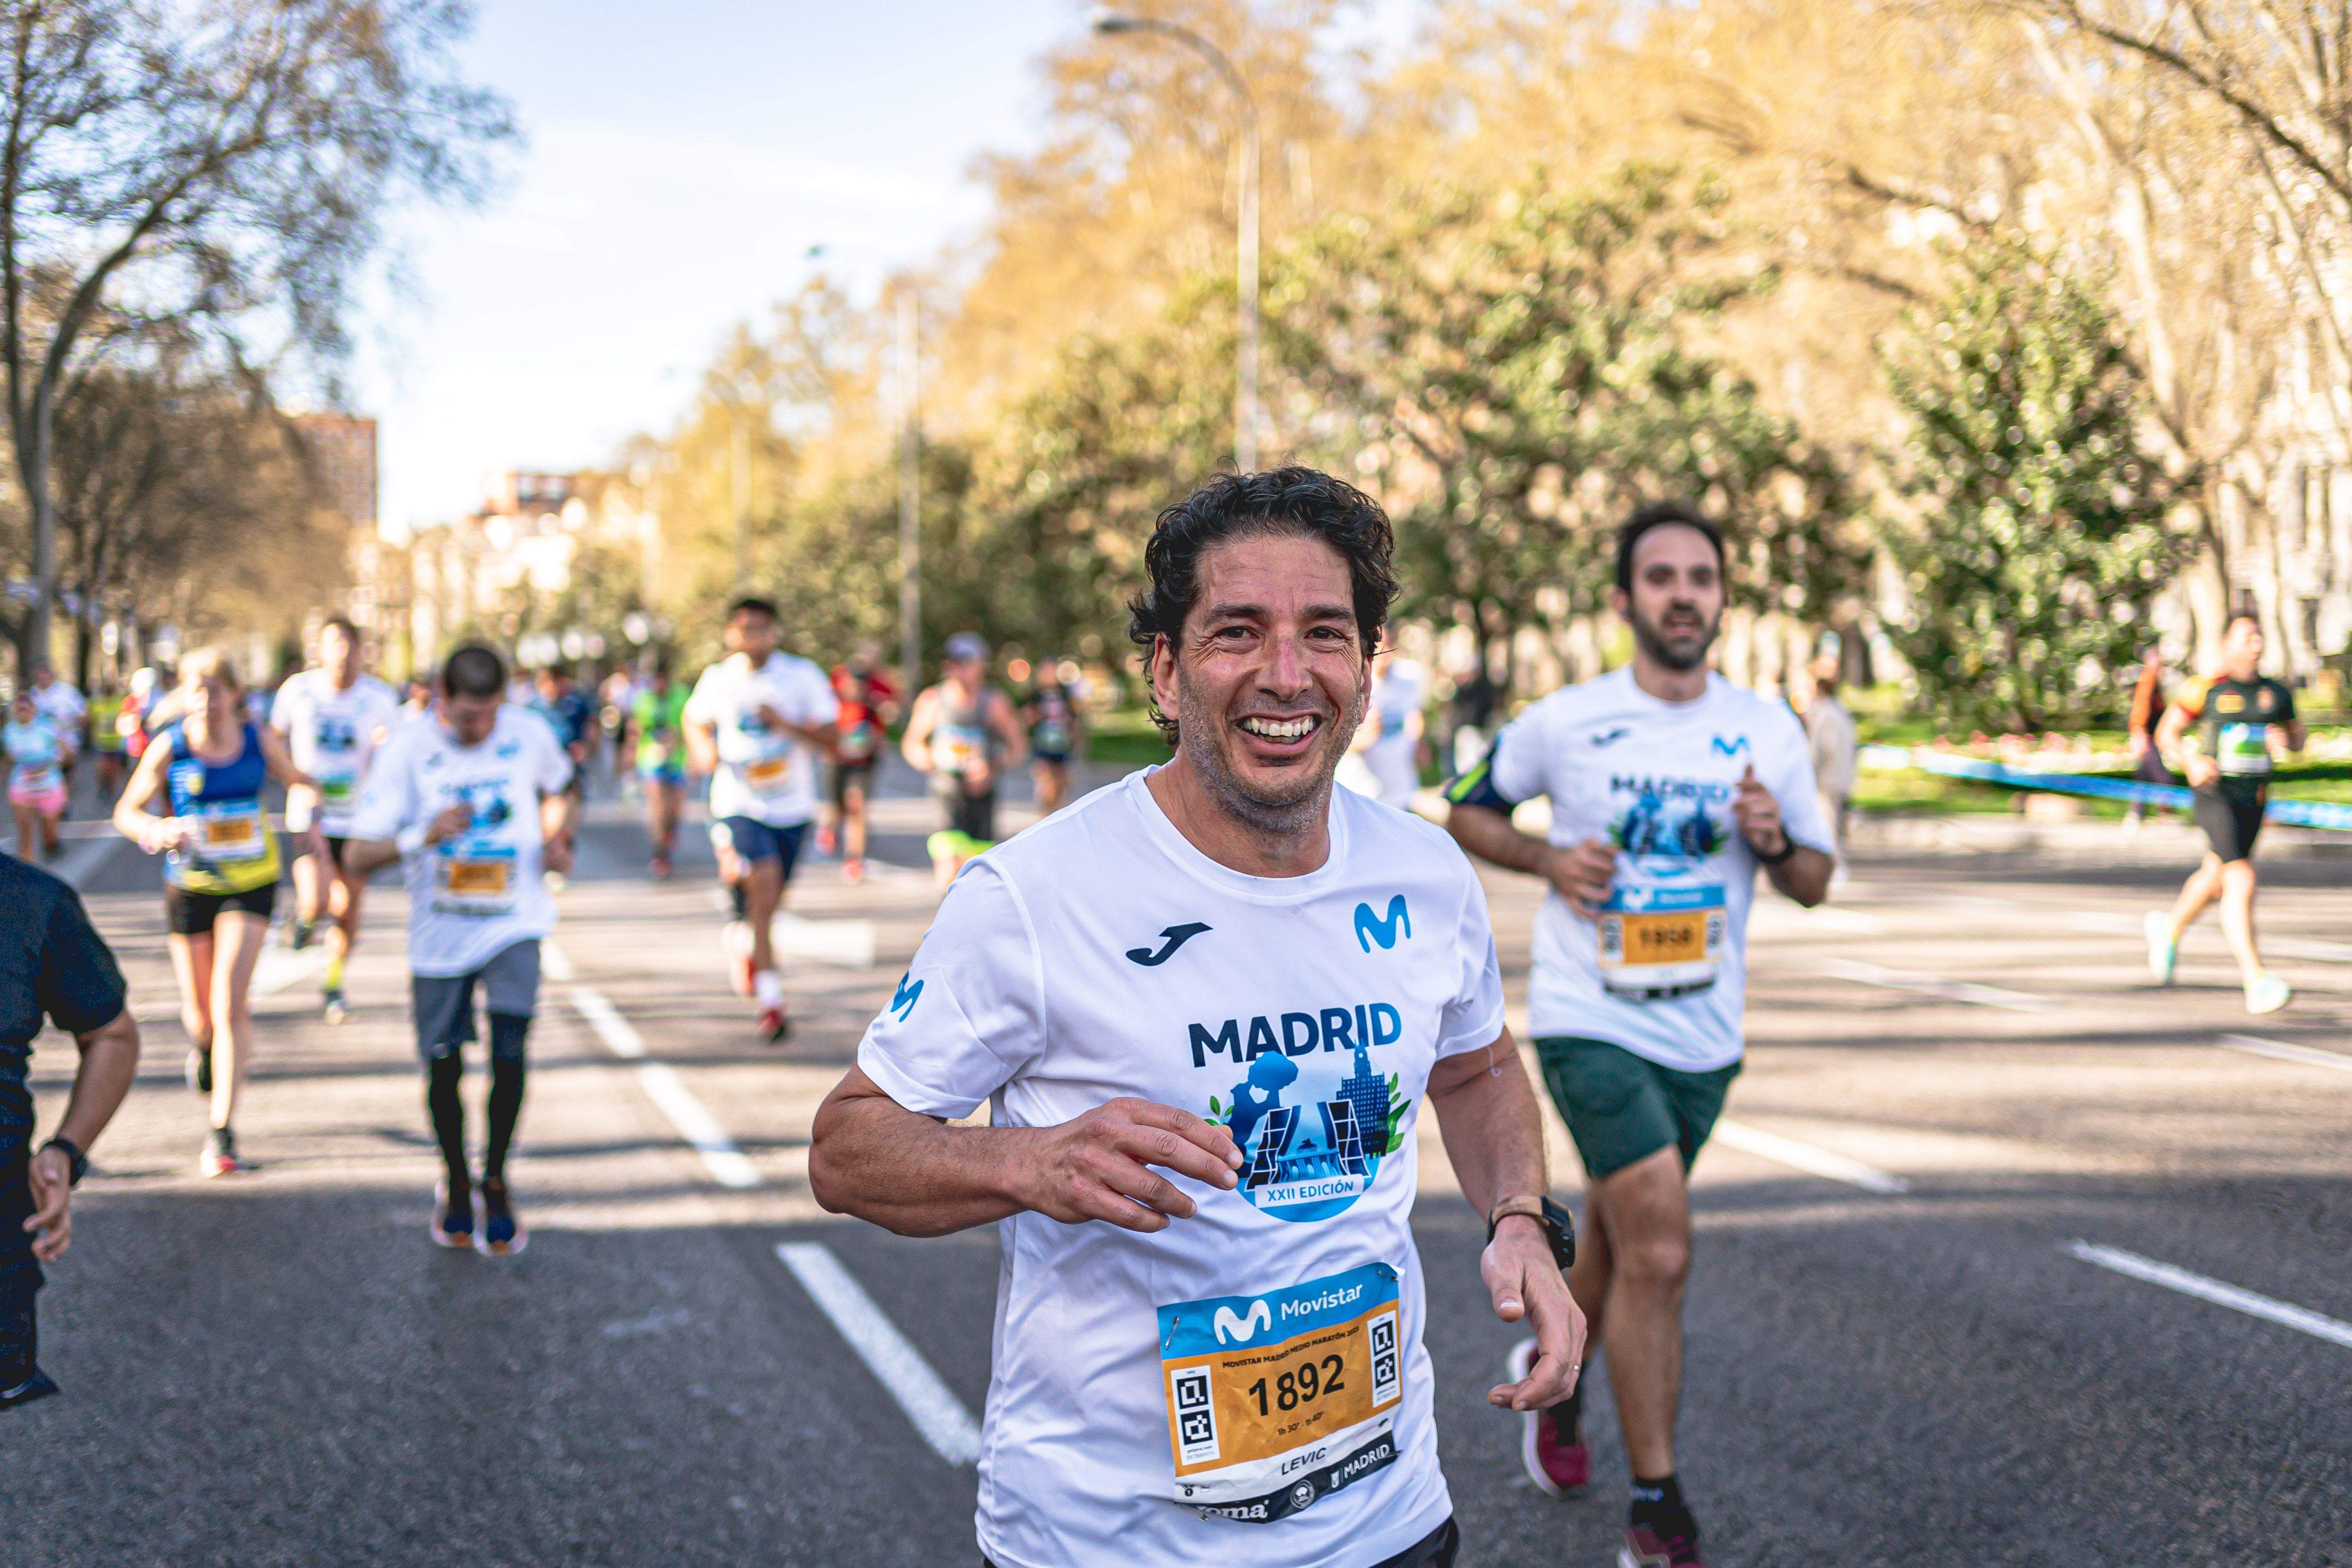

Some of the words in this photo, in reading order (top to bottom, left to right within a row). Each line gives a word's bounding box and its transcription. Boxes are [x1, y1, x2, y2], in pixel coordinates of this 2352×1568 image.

[1188, 1003, 1402, 1068] MADRID
[1267, 1188, 1295, 1202] XXII
[1300, 1179, 1353, 1198] EDICIÓN
[1281, 1284, 1363, 1321] Movistar
[1222, 1357, 1262, 1368] MOVISTAR
[1248, 1354, 1345, 1416] 1892
[1281, 1447, 1327, 1476] LEVIC
[1344, 1444, 1390, 1479] MADRID
